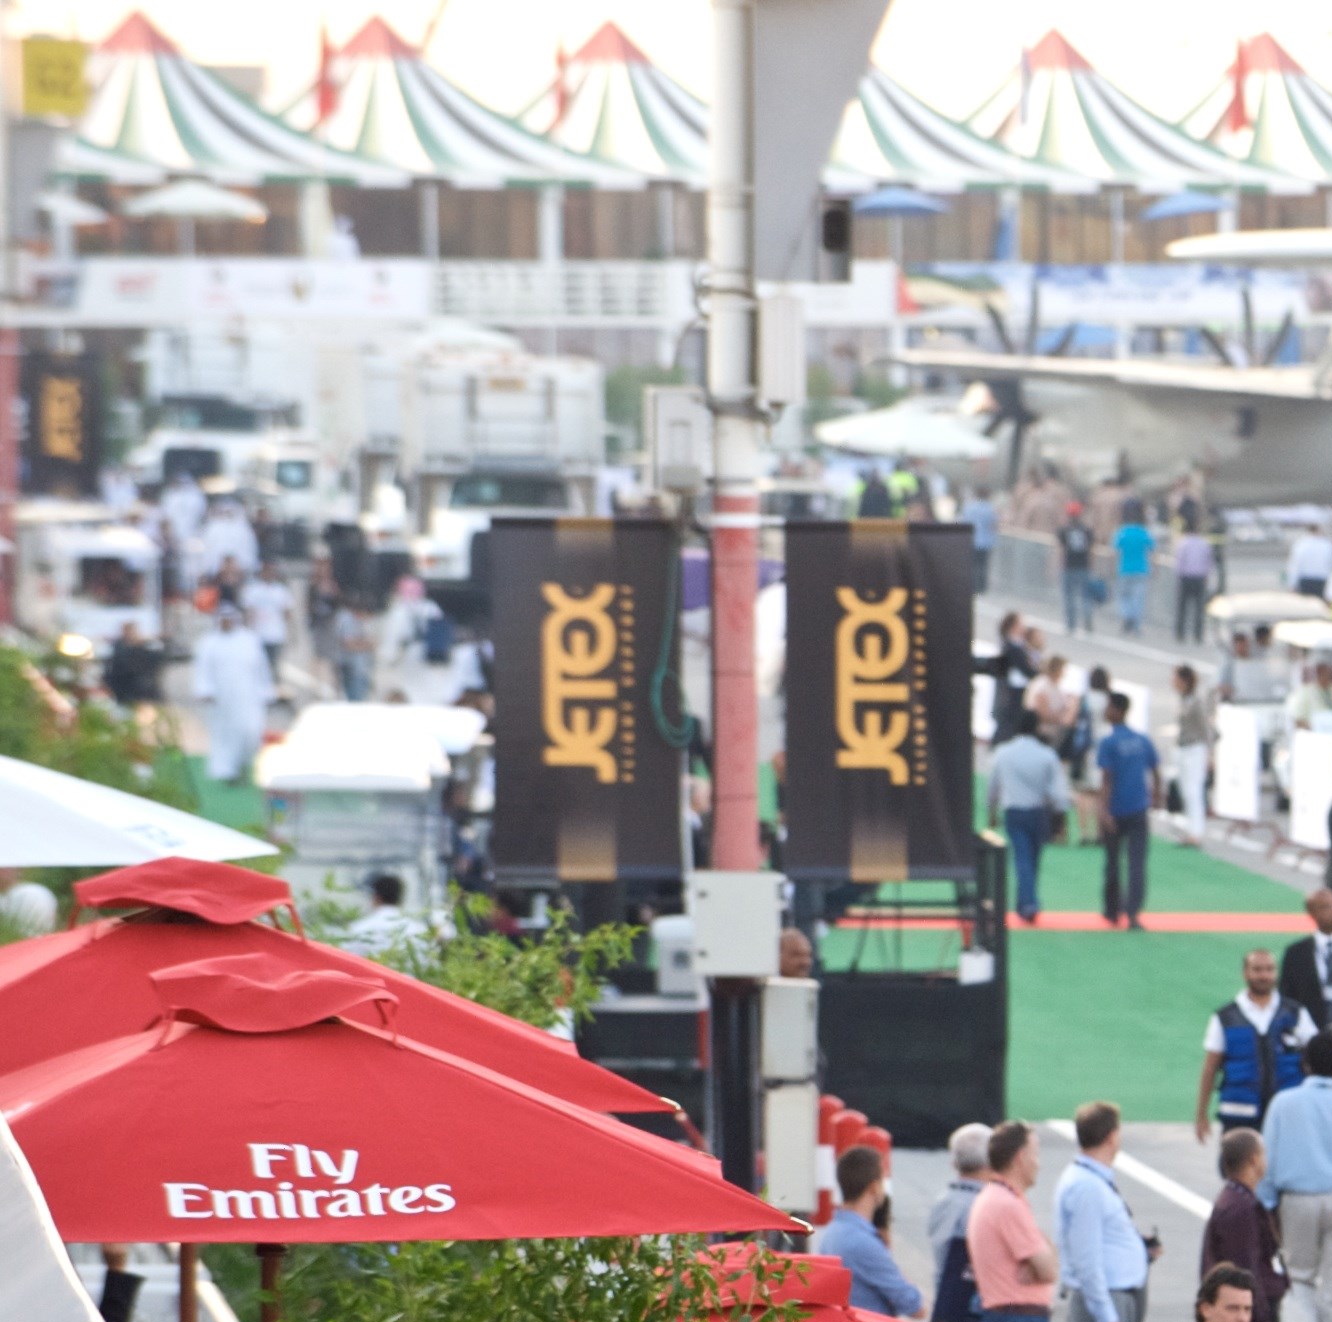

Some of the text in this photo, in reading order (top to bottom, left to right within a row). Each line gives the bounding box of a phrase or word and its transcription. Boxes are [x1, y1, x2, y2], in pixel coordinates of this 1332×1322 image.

[541, 582, 618, 784] JETEX
[835, 586, 909, 786] JETEX
[162, 1181, 457, 1220] Emirates
[247, 1142, 360, 1185] Fly
